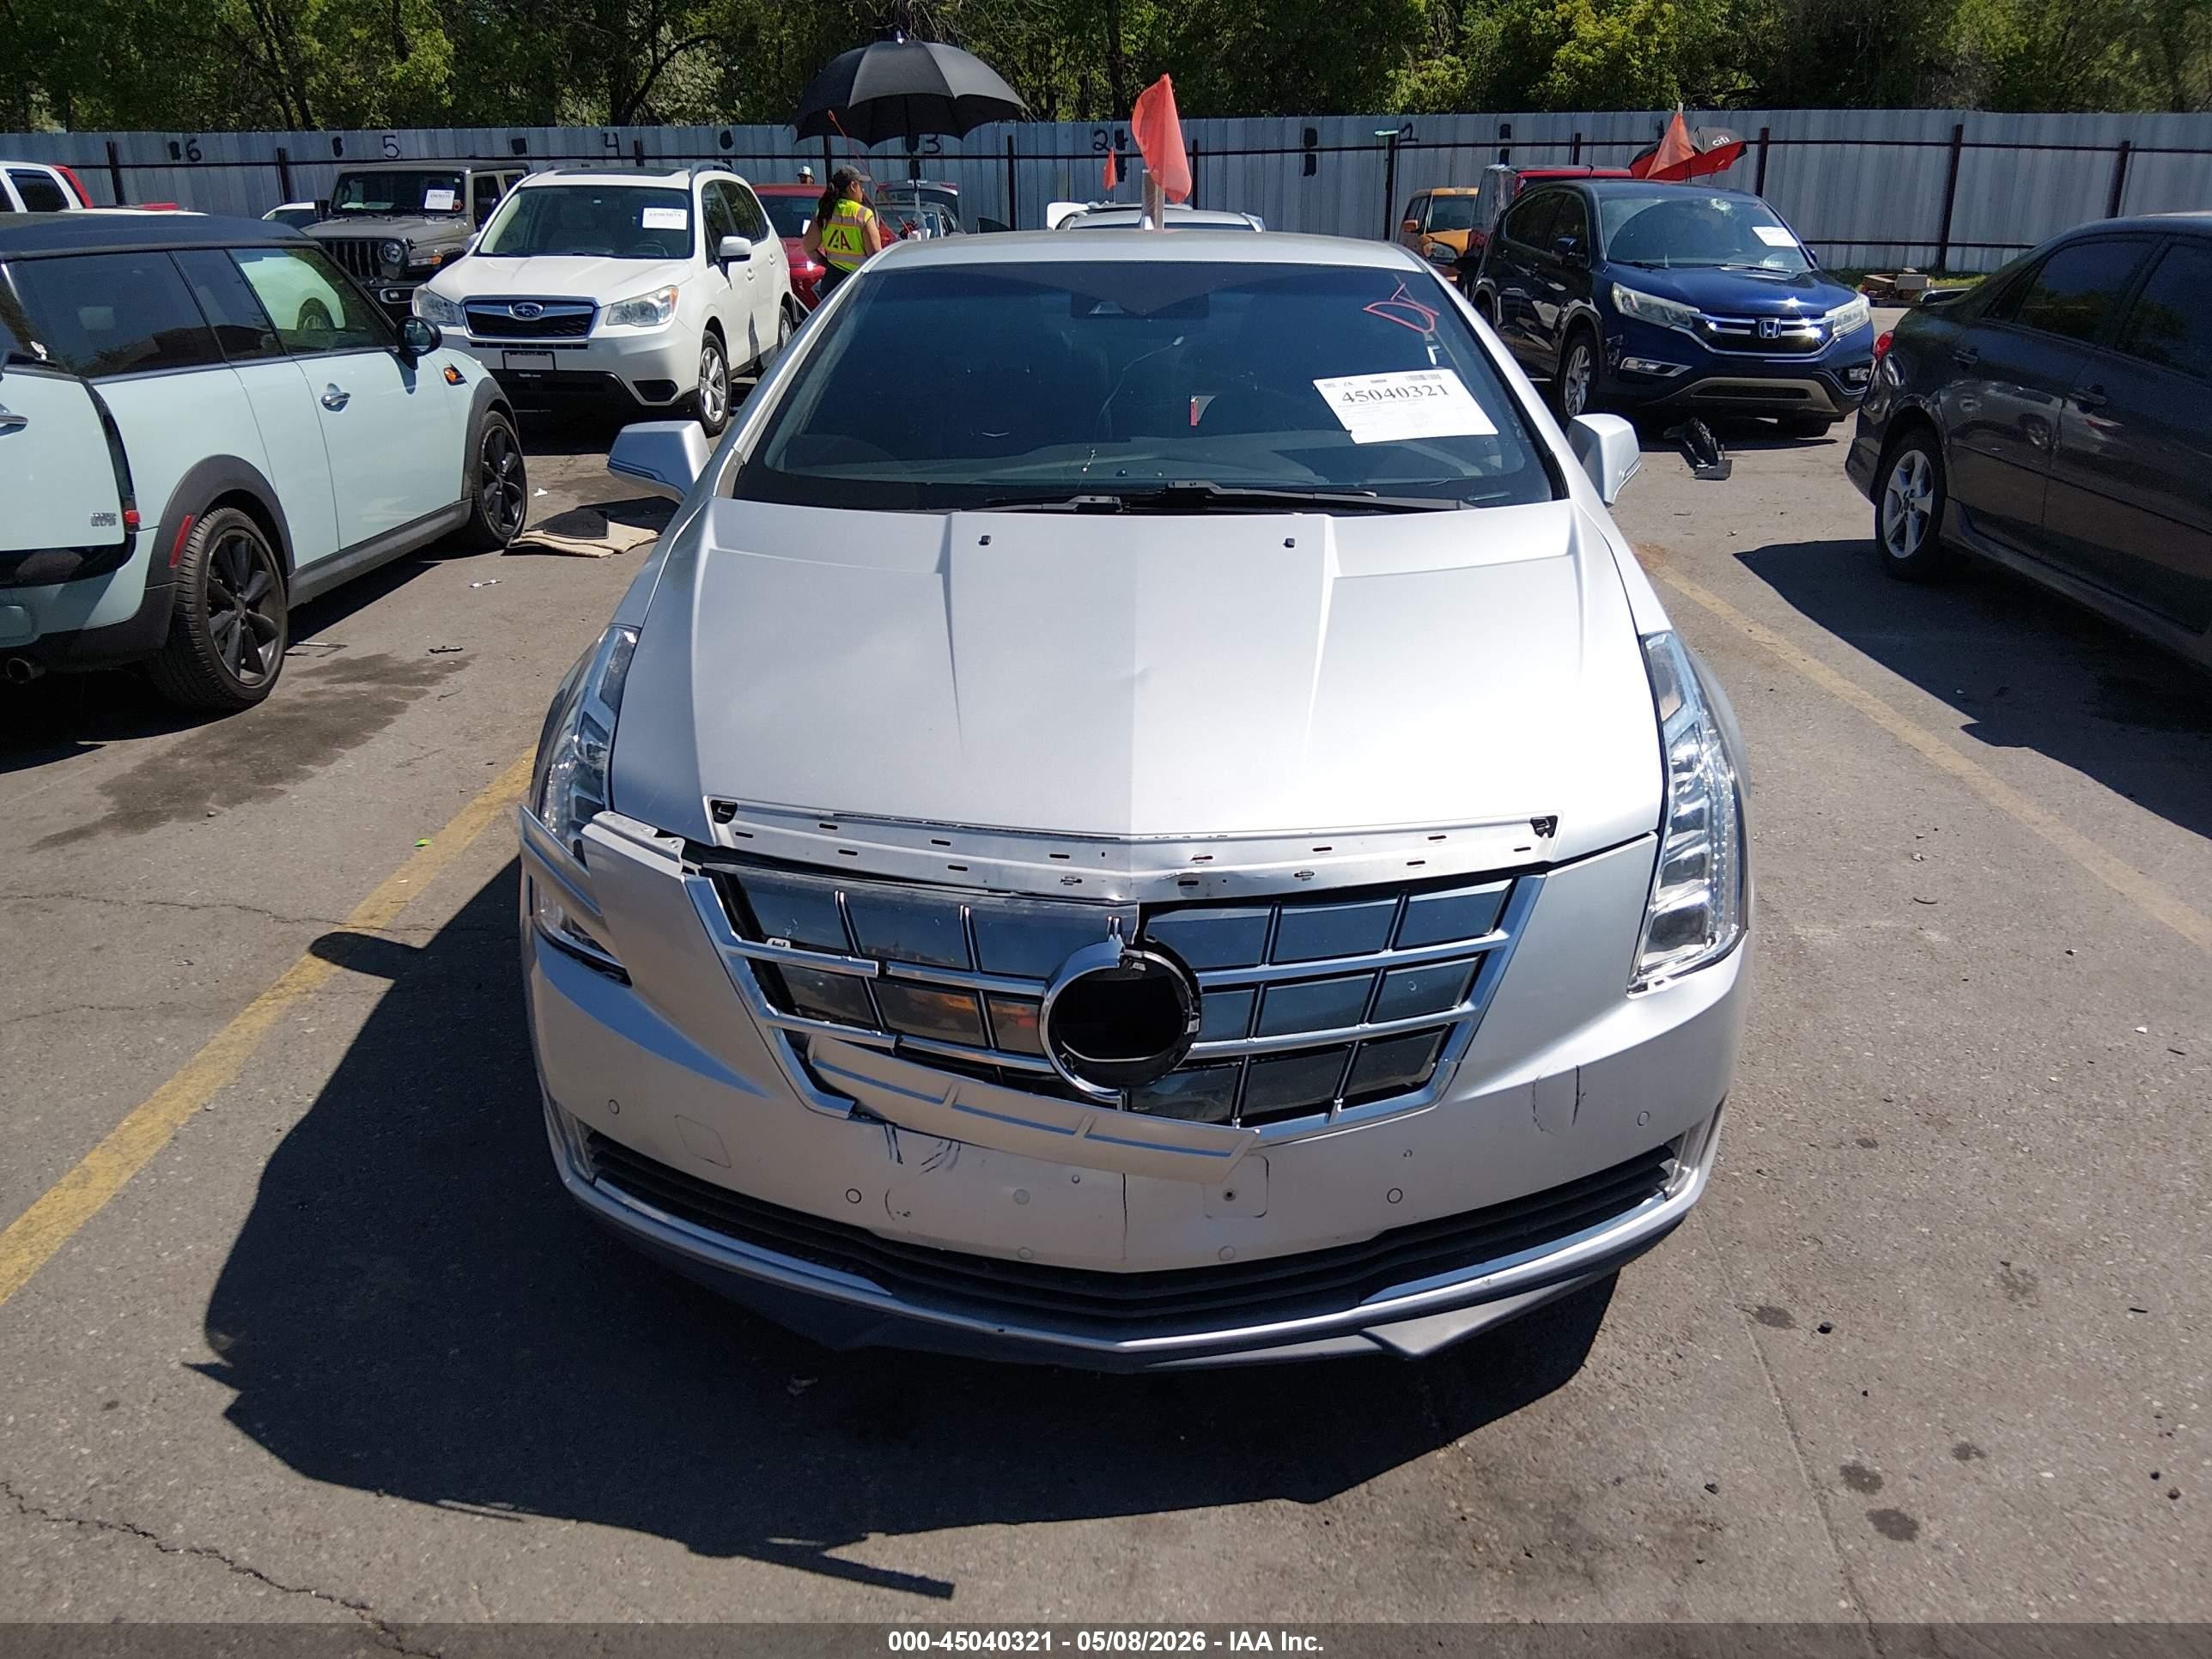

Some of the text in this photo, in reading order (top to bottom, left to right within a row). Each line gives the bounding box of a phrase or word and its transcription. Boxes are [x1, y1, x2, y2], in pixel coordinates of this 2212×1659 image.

[185, 138, 202, 162] 6
[382, 135, 400, 159] 5
[604, 132, 620, 158] 4
[924, 133, 941, 154] 3
[1093, 130, 1110, 151] 2
[1712, 135, 1730, 146] citi
[1341, 384, 1449, 403] 45040321
